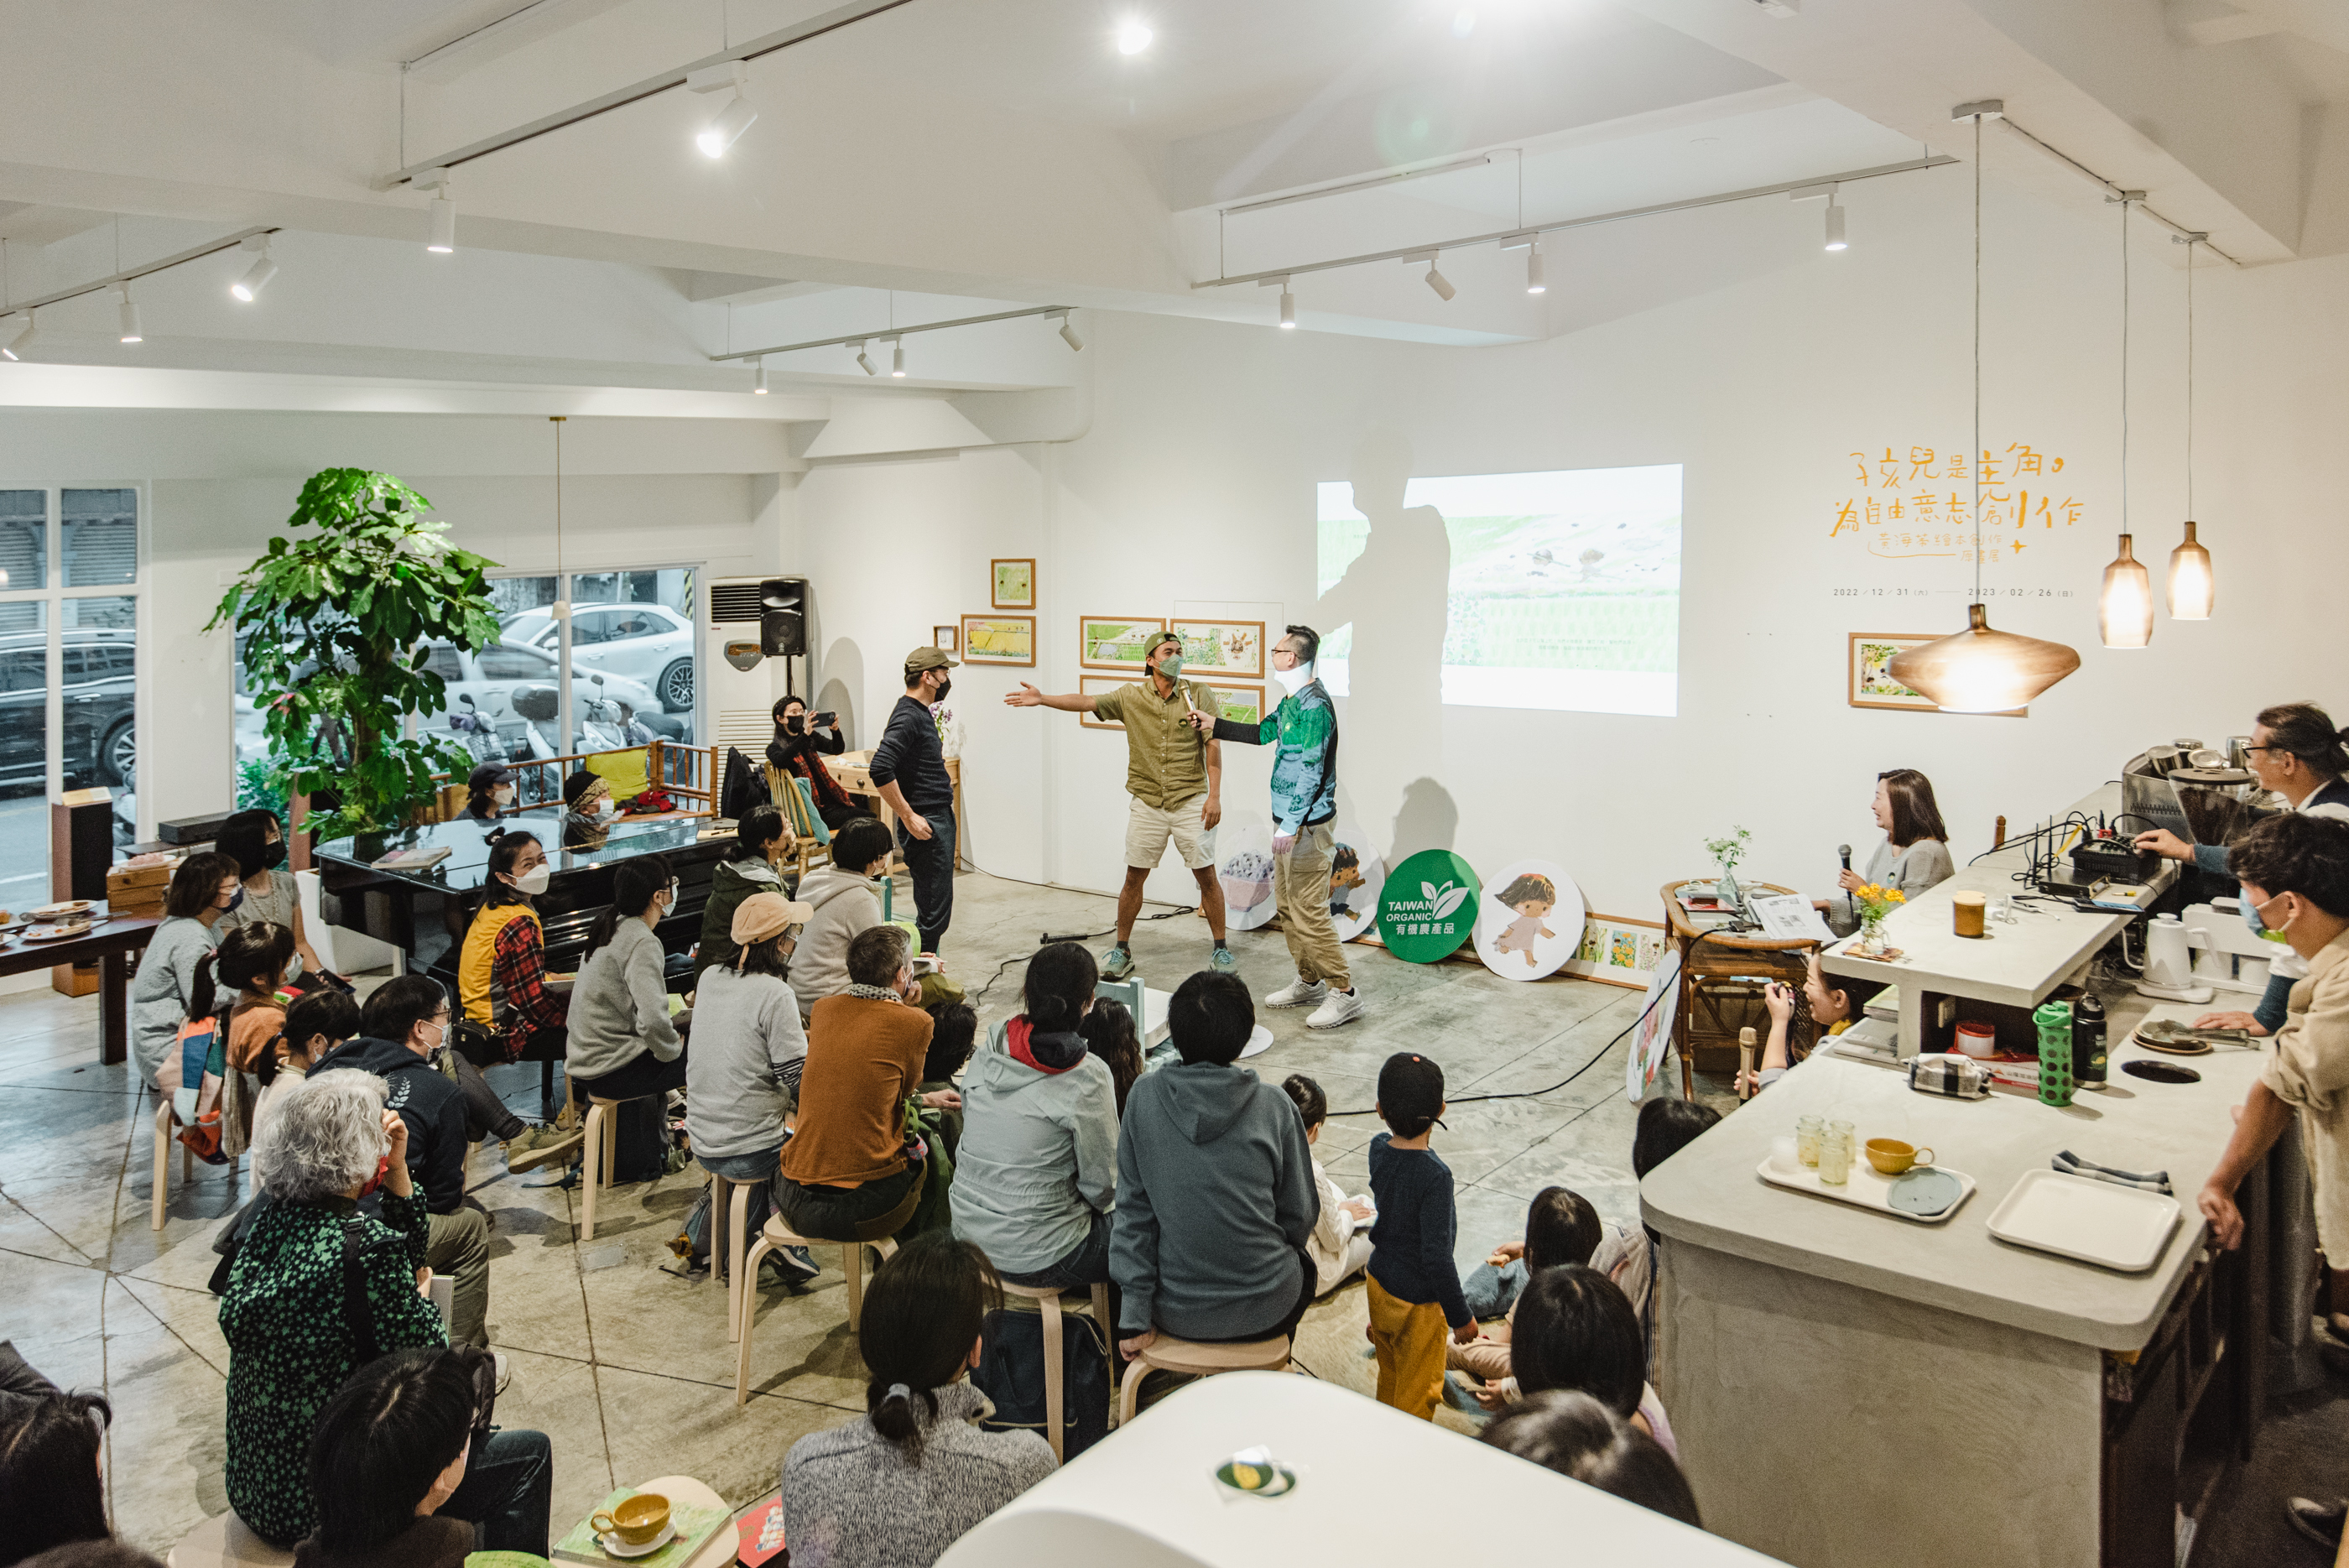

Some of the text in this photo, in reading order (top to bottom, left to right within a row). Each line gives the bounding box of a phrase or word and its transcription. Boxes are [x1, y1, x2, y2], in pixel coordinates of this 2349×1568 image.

[1828, 487, 2086, 539] 為自由意志創作
[1388, 900, 1434, 912] TAIWAN
[1386, 912, 1432, 922] ORGANIC
[1395, 922, 1455, 935] 有機農產品
